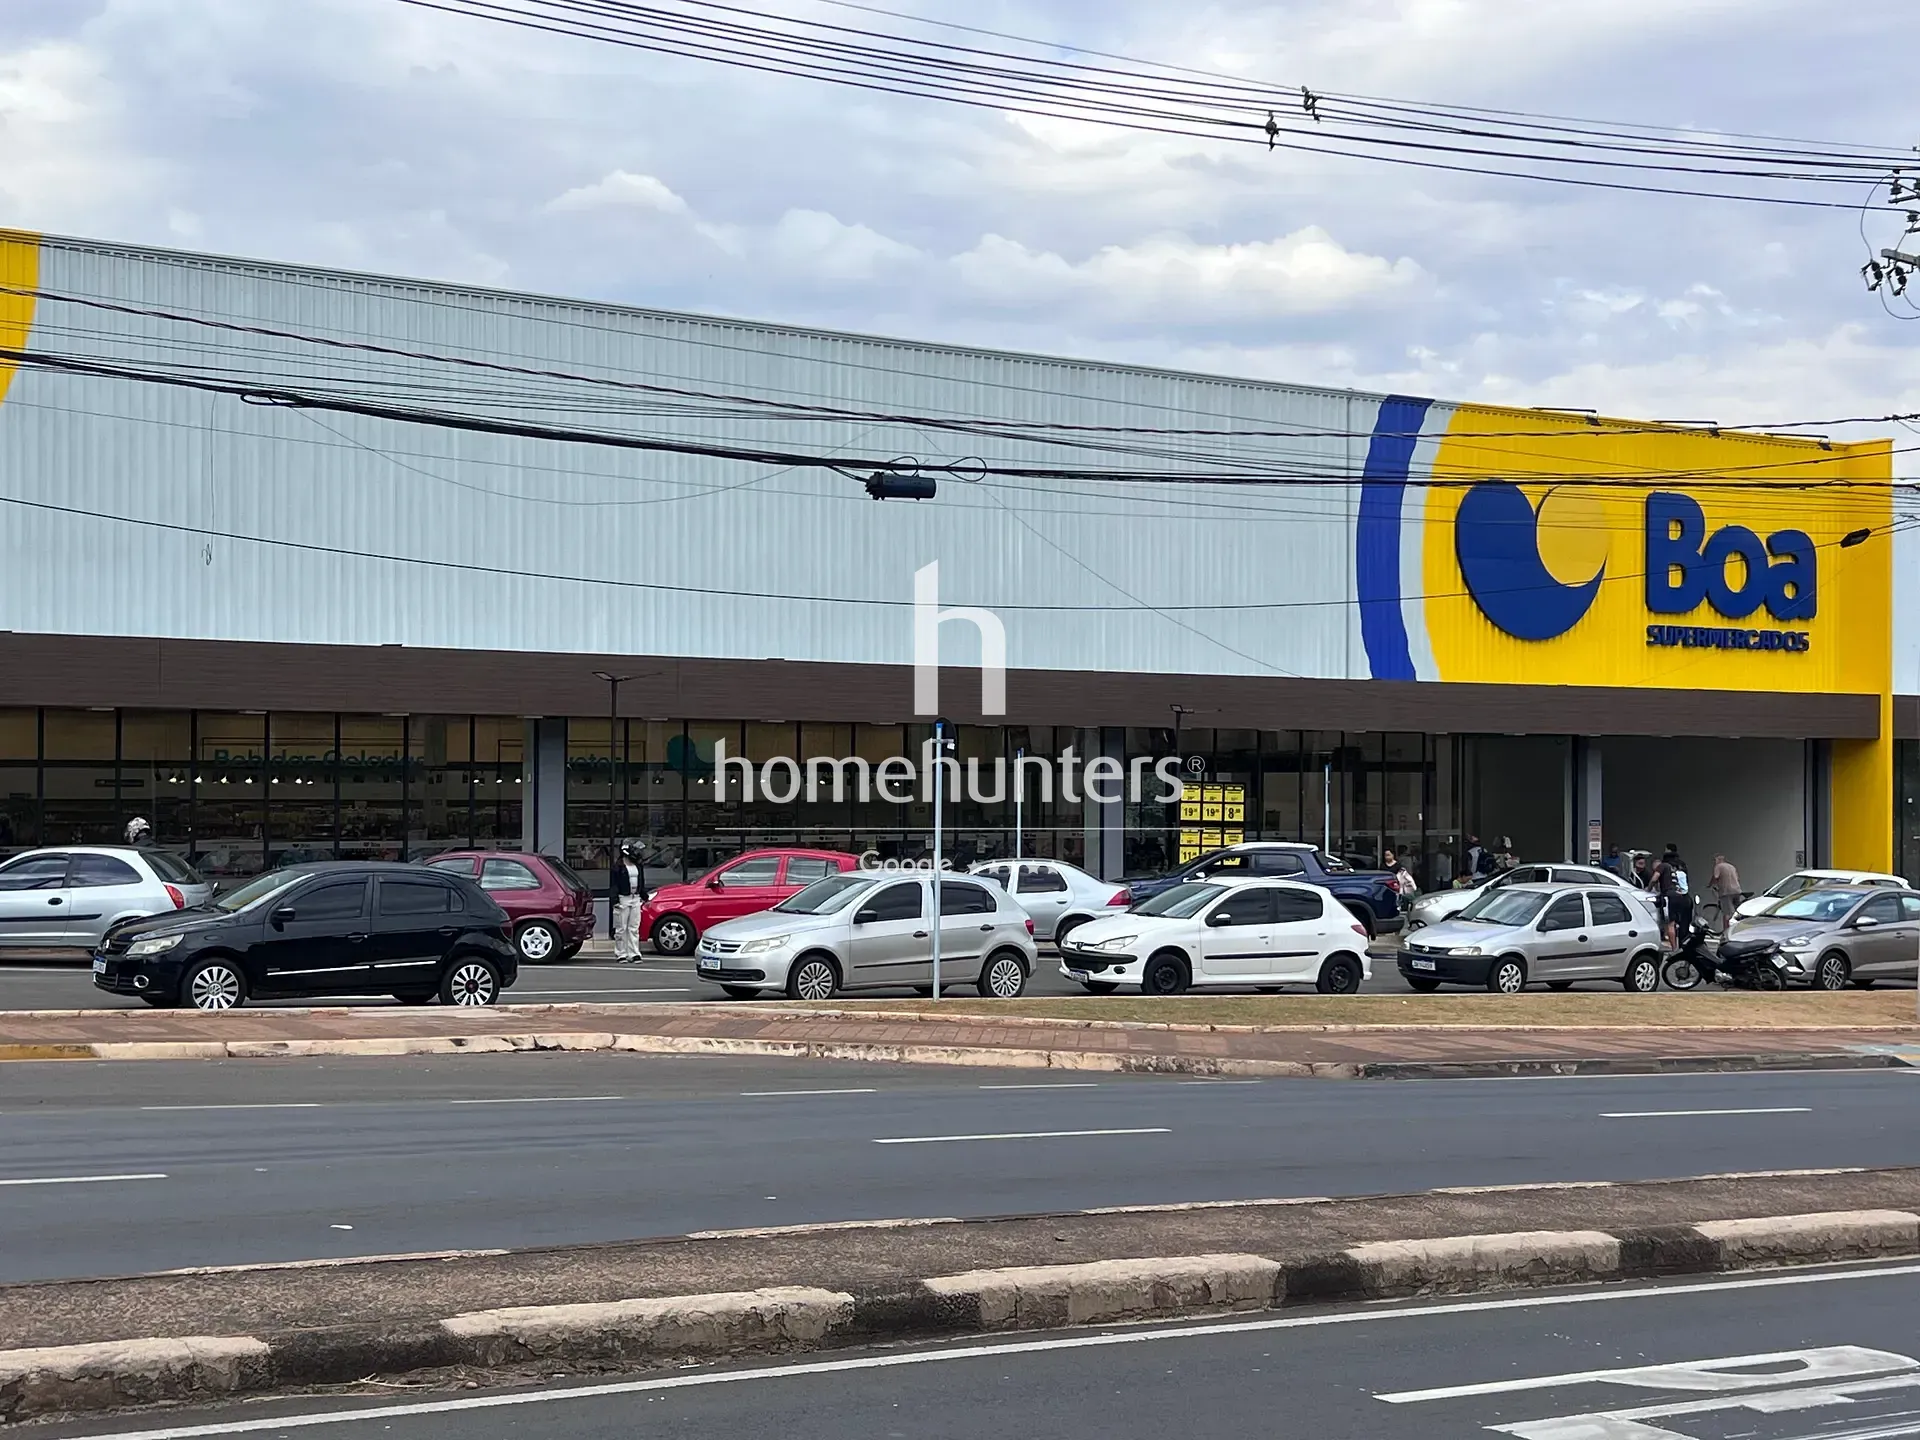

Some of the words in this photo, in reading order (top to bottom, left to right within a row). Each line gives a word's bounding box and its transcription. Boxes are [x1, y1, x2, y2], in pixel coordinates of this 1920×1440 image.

[1645, 491, 1817, 621] Boa
[1646, 625, 1810, 651] SUPERMERCADOS
[214, 749, 317, 768] Bebdas
